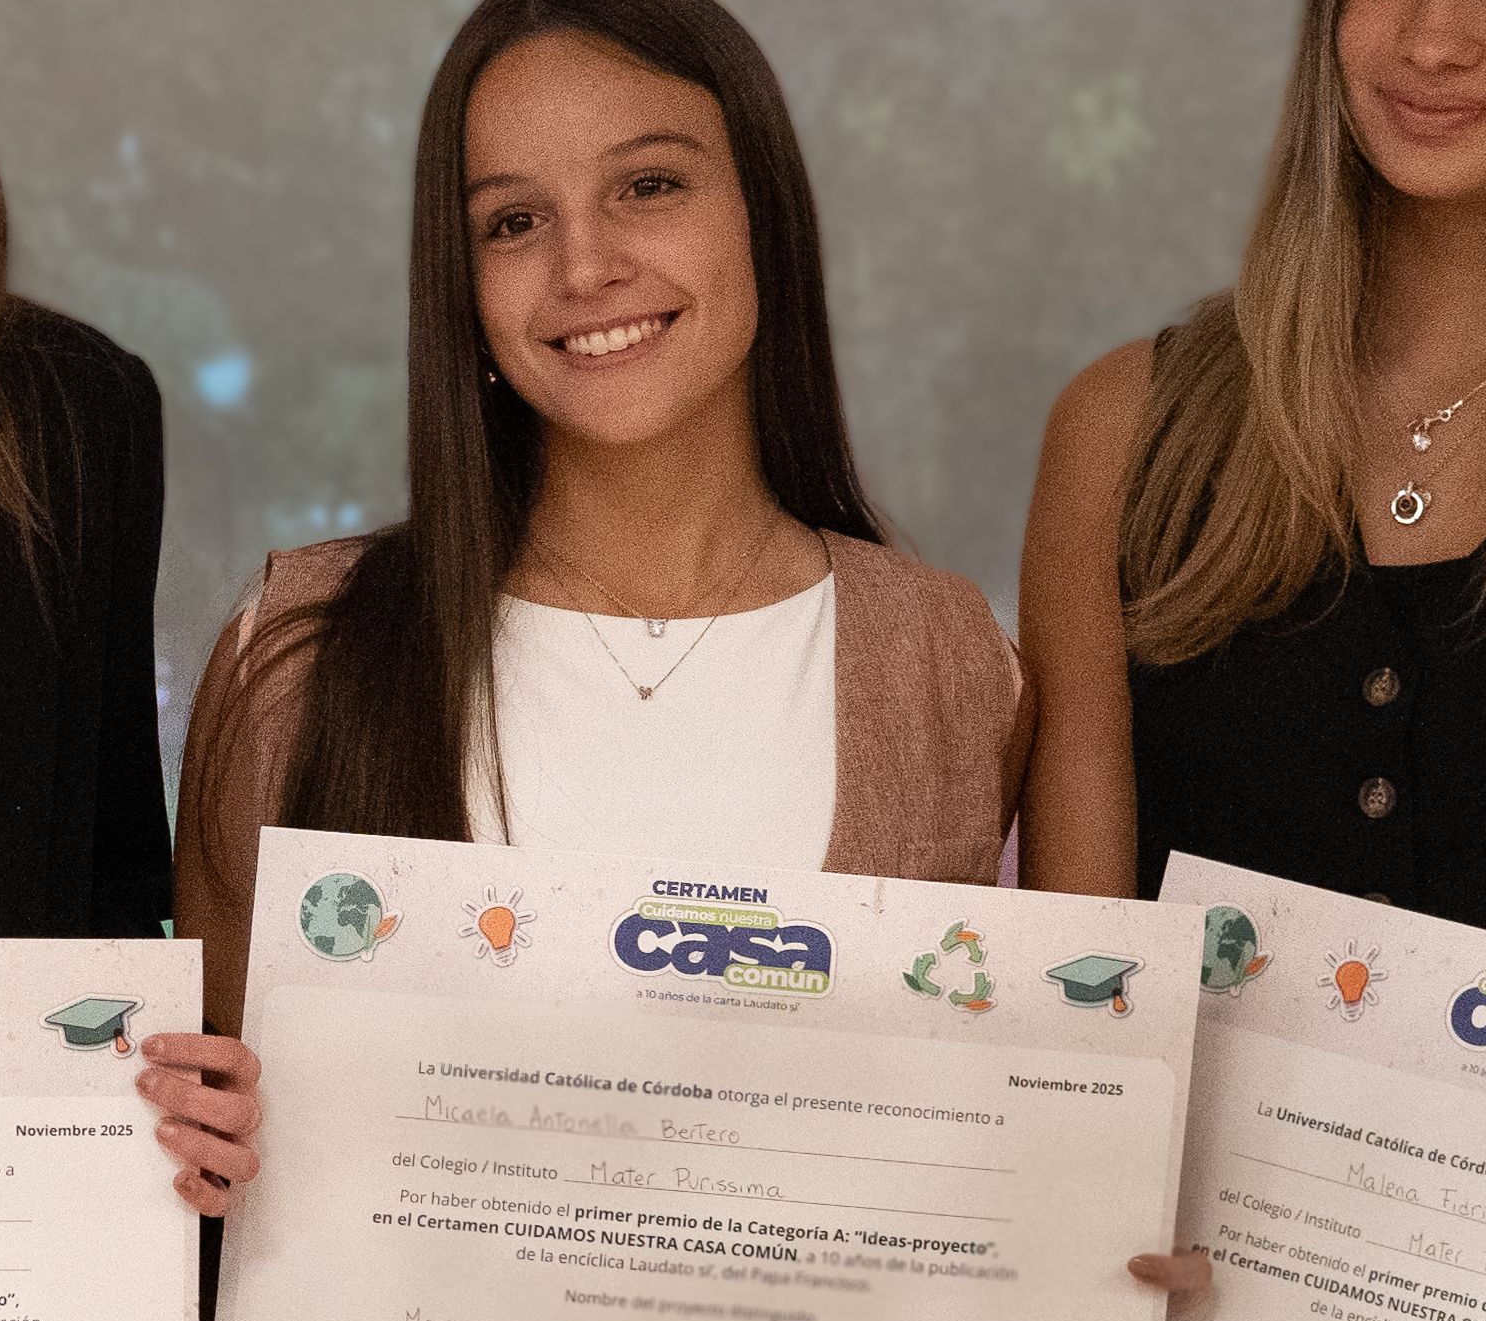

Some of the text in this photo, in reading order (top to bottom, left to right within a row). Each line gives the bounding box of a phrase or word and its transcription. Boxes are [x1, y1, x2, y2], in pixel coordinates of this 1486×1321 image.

[652, 880, 768, 904] CERTAMEN
[641, 904, 772, 927] Cuidamos nuestra
[614, 913, 833, 977] casa
[728, 961, 824, 991] común
[1008, 1075, 1124, 1097] Noviembre 2025
[15, 1124, 134, 1137] Noviembre 2025
[1256, 1102, 1273, 1118] La
[1276, 1107, 1363, 1142] Universidad
[1365, 1131, 1425, 1159] Católica
[1427, 1149, 1447, 1165] de
[5, 1165, 15, 1177] a
